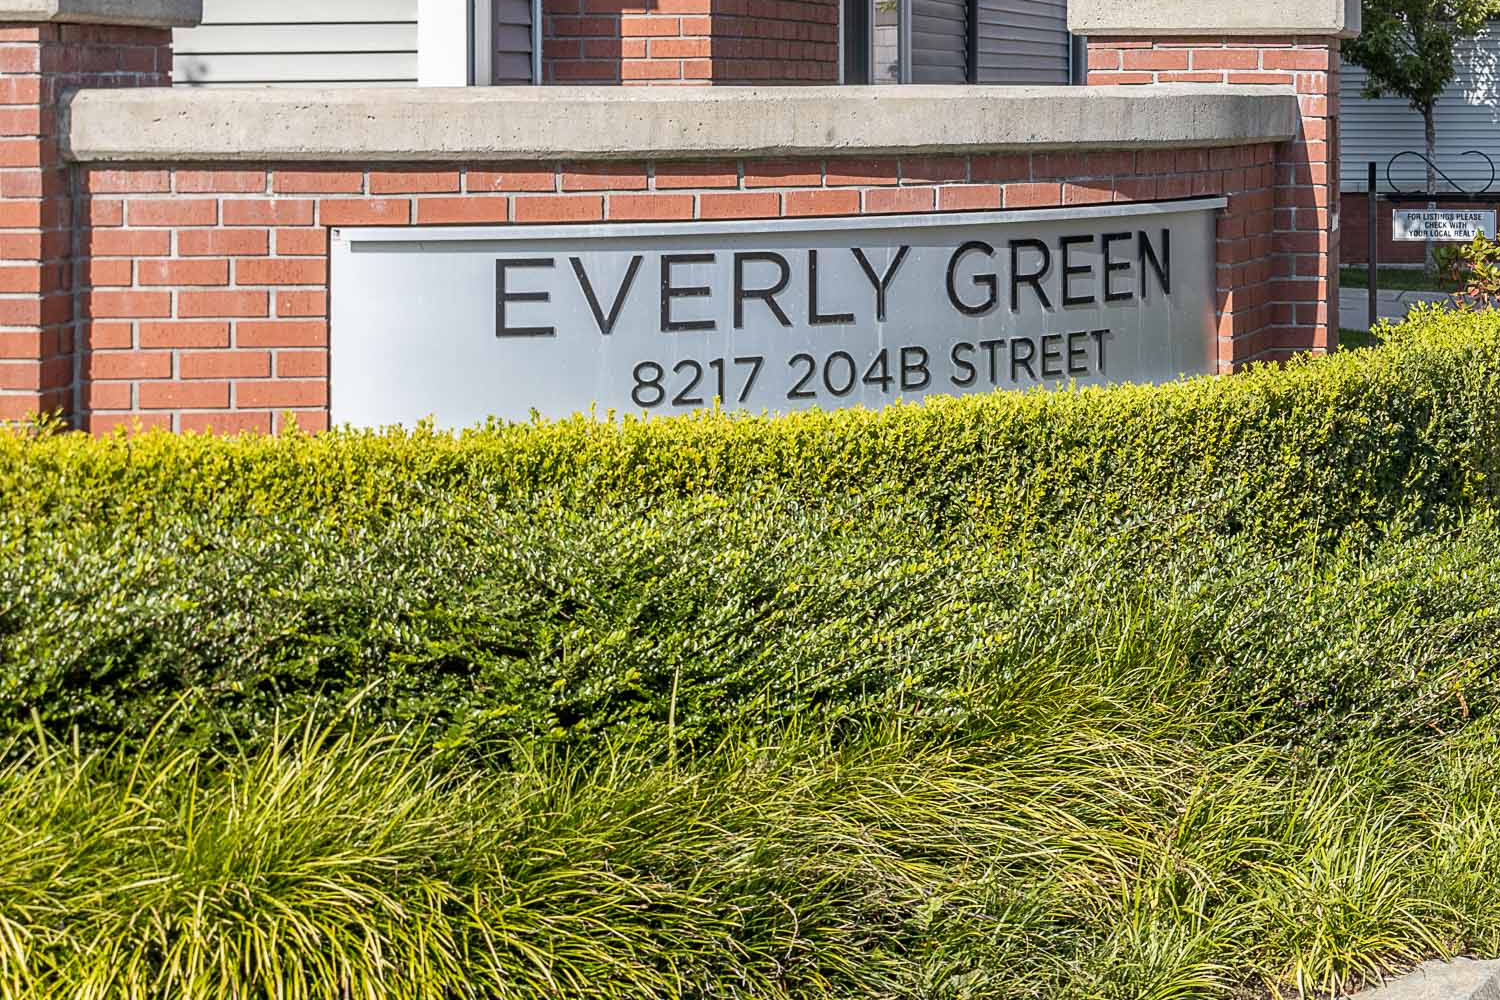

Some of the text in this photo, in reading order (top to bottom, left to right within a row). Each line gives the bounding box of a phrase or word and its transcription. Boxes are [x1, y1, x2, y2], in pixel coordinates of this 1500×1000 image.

[1407, 213, 1482, 221] FOR LISTINGS PLEASE
[1424, 221, 1467, 229] CHECK WITH
[1409, 229, 1485, 237] YOUR LOCAL REALTR
[495, 227, 1171, 338] EVERLY GREEN
[630, 328, 1112, 408] 8217 204B STREET
